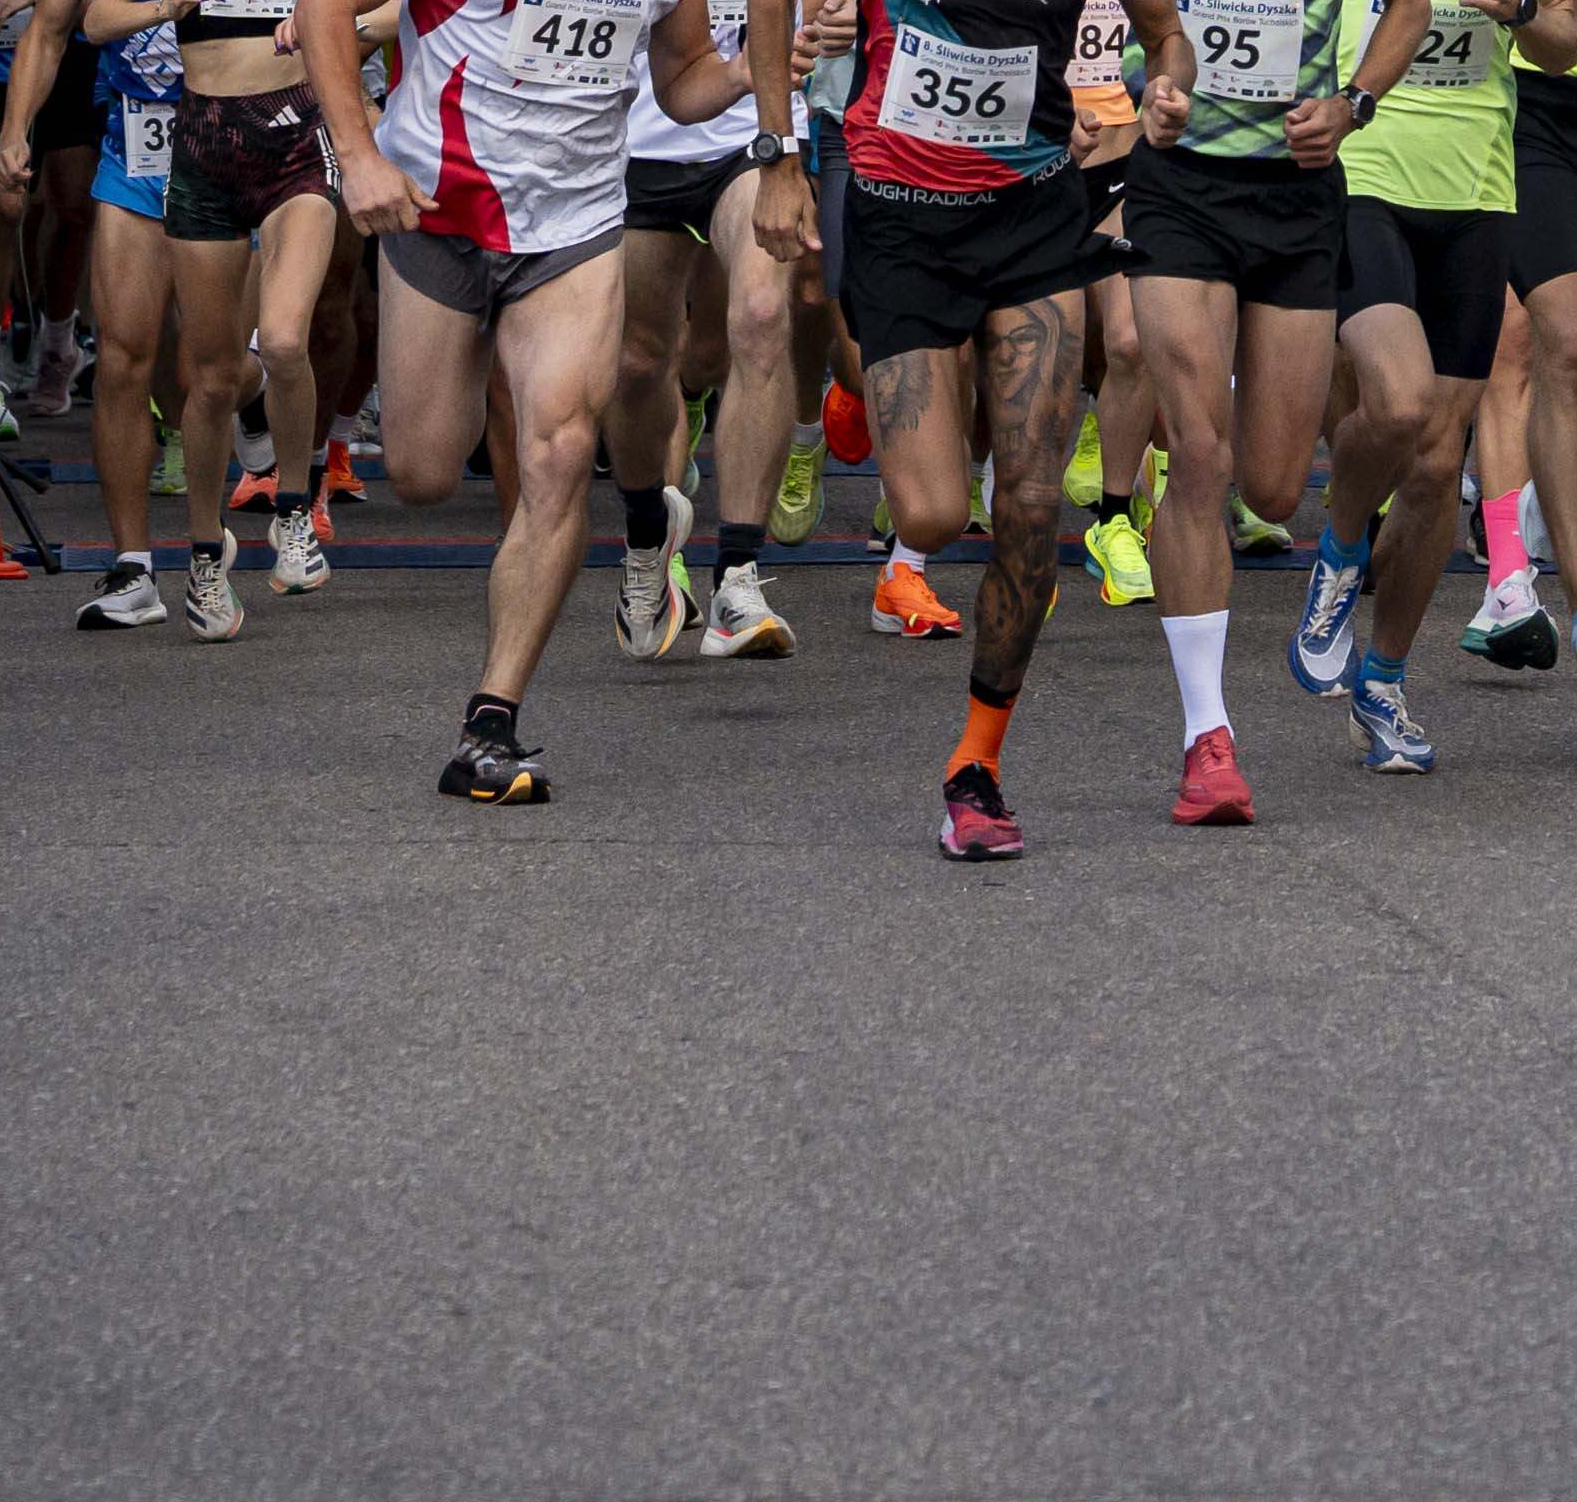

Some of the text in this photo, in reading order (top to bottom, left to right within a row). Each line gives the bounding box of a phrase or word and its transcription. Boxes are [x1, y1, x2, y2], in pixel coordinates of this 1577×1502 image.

[1257, 2, 1299, 18] Dyszka
[532, 13, 617, 60] 418
[923, 40, 1029, 69] 8. Śliwicka Dyszka
[1201, 24, 1262, 71] 95
[910, 67, 1007, 119] 356
[913, 188, 998, 207] RADICAL
